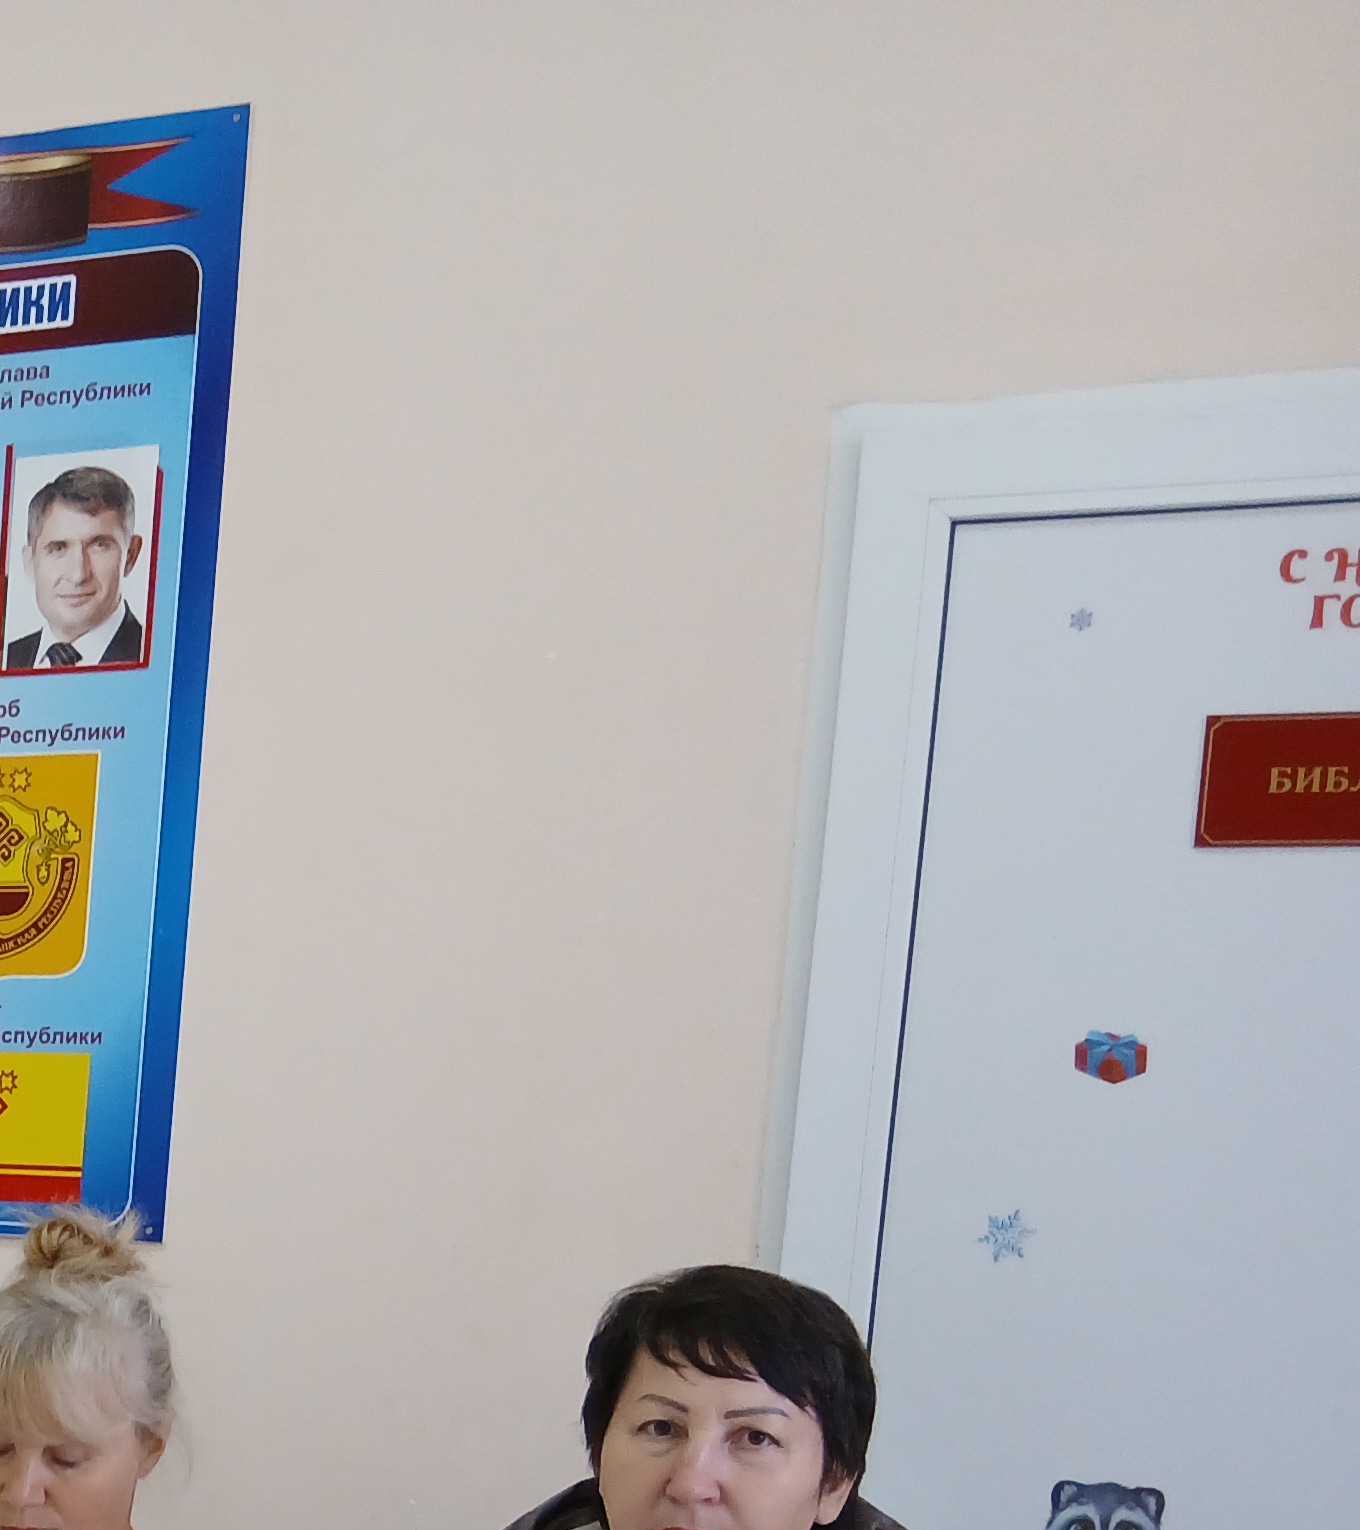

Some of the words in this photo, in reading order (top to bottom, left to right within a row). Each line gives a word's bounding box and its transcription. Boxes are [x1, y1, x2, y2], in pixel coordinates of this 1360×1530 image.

[19, 380, 151, 409] Республики
[1280, 549, 1309, 584] С
[1268, 765, 1360, 794] БИБ
